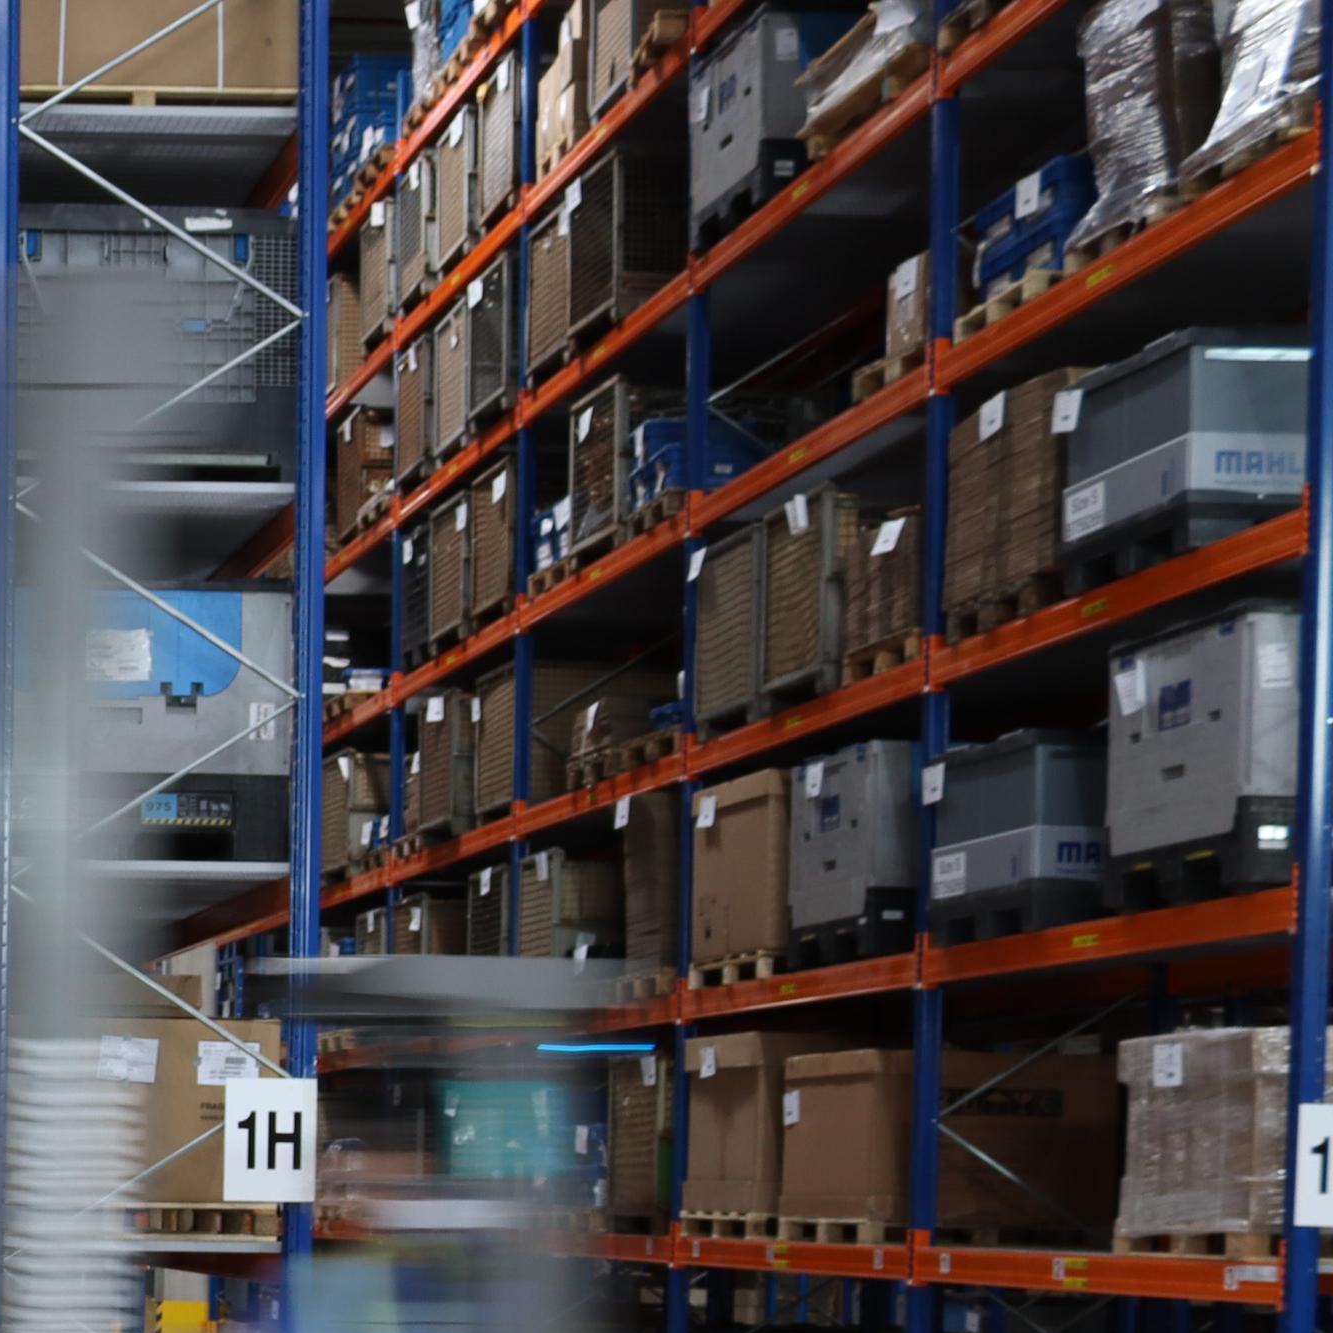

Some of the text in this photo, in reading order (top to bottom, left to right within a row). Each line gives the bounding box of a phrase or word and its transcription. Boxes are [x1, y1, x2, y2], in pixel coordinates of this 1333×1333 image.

[1214, 450, 1302, 475] MAHL
[238, 1111, 302, 1170] 1H
[1311, 1137, 1331, 1194] 1
